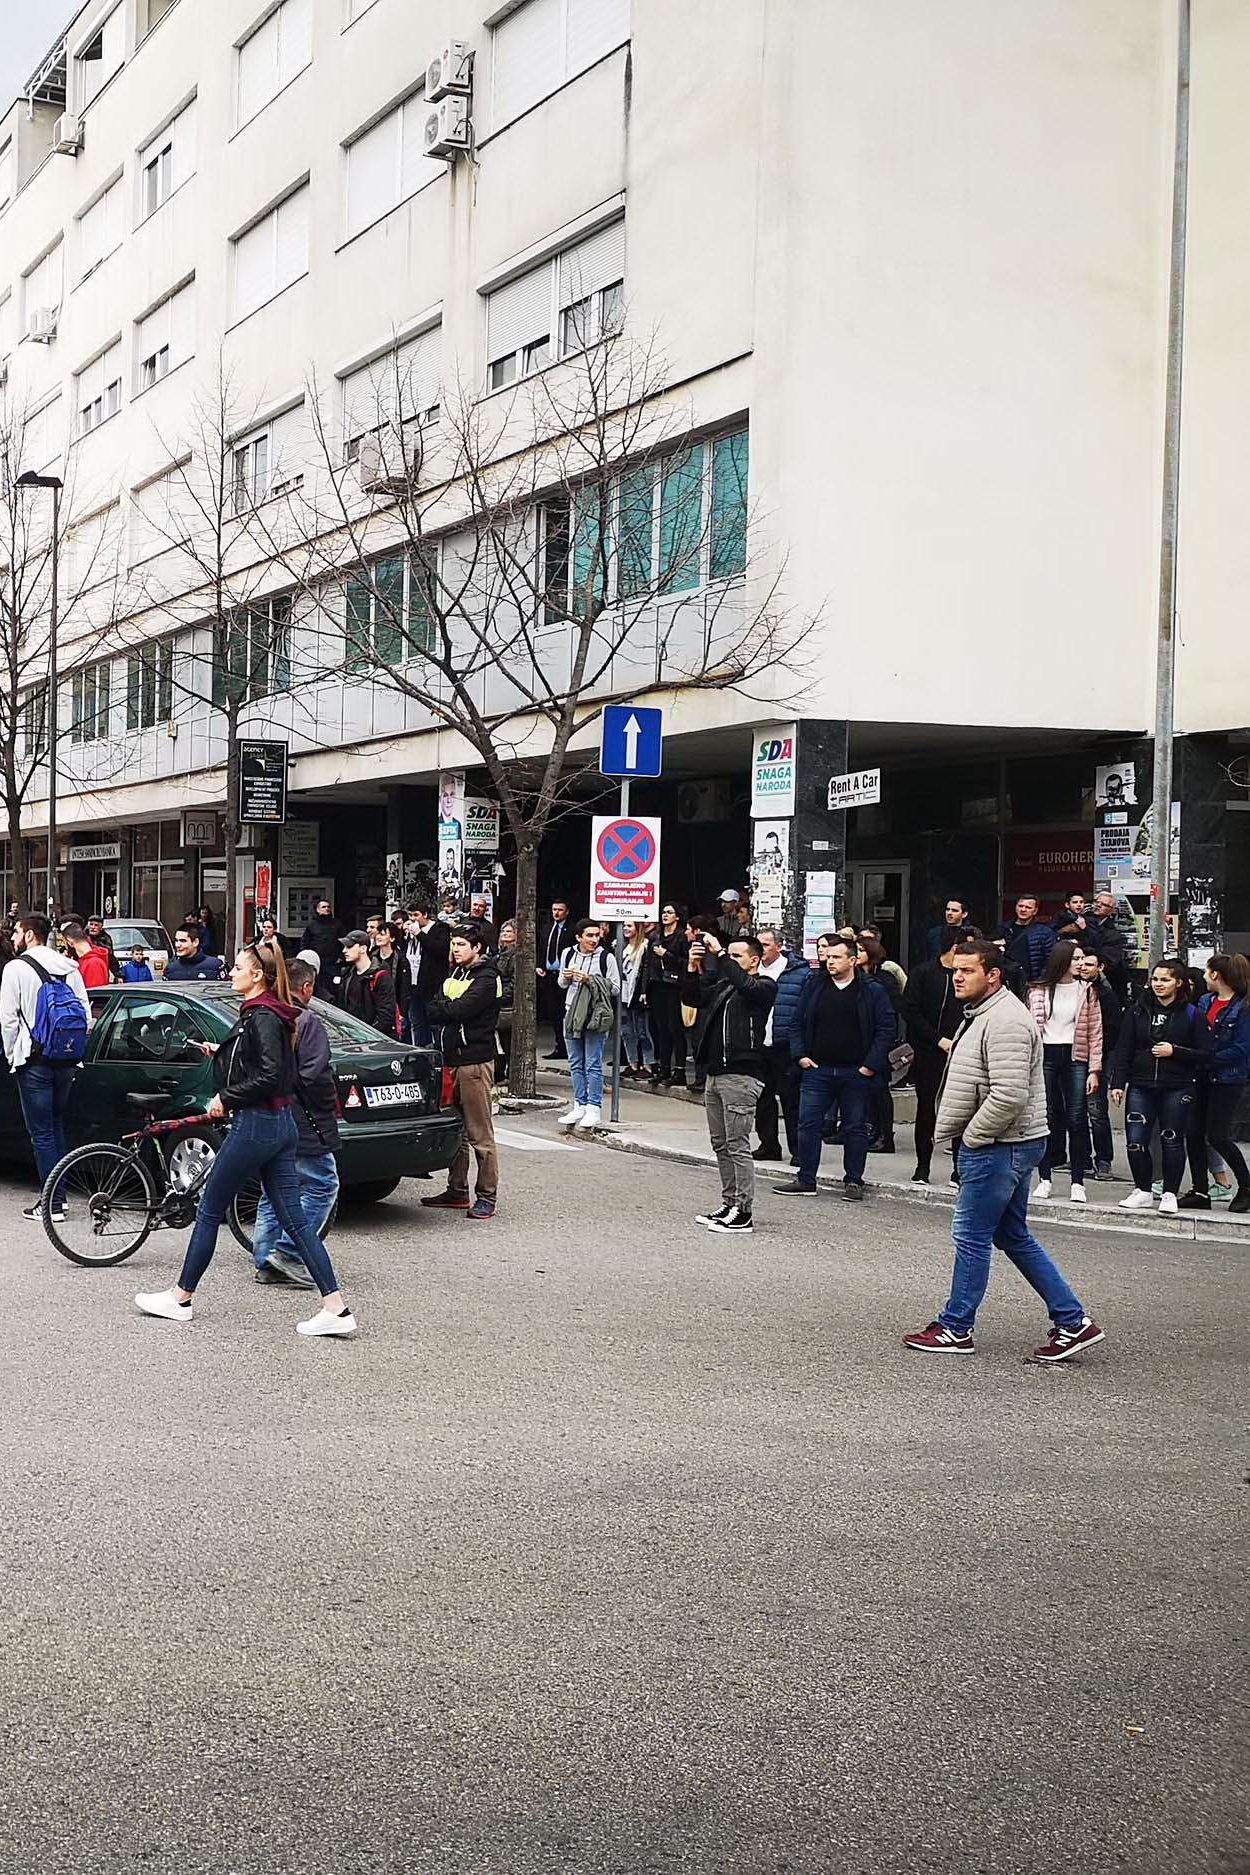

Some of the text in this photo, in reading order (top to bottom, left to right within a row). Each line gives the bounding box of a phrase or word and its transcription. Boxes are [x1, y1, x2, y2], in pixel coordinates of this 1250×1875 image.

[756, 738, 792, 762] SDA
[756, 766, 792, 781] SNAGA
[756, 780, 792, 792] NARODA
[830, 774, 878, 795] Rent A Car
[466, 806, 497, 820] SDA
[465, 822, 496, 831] SNAGA
